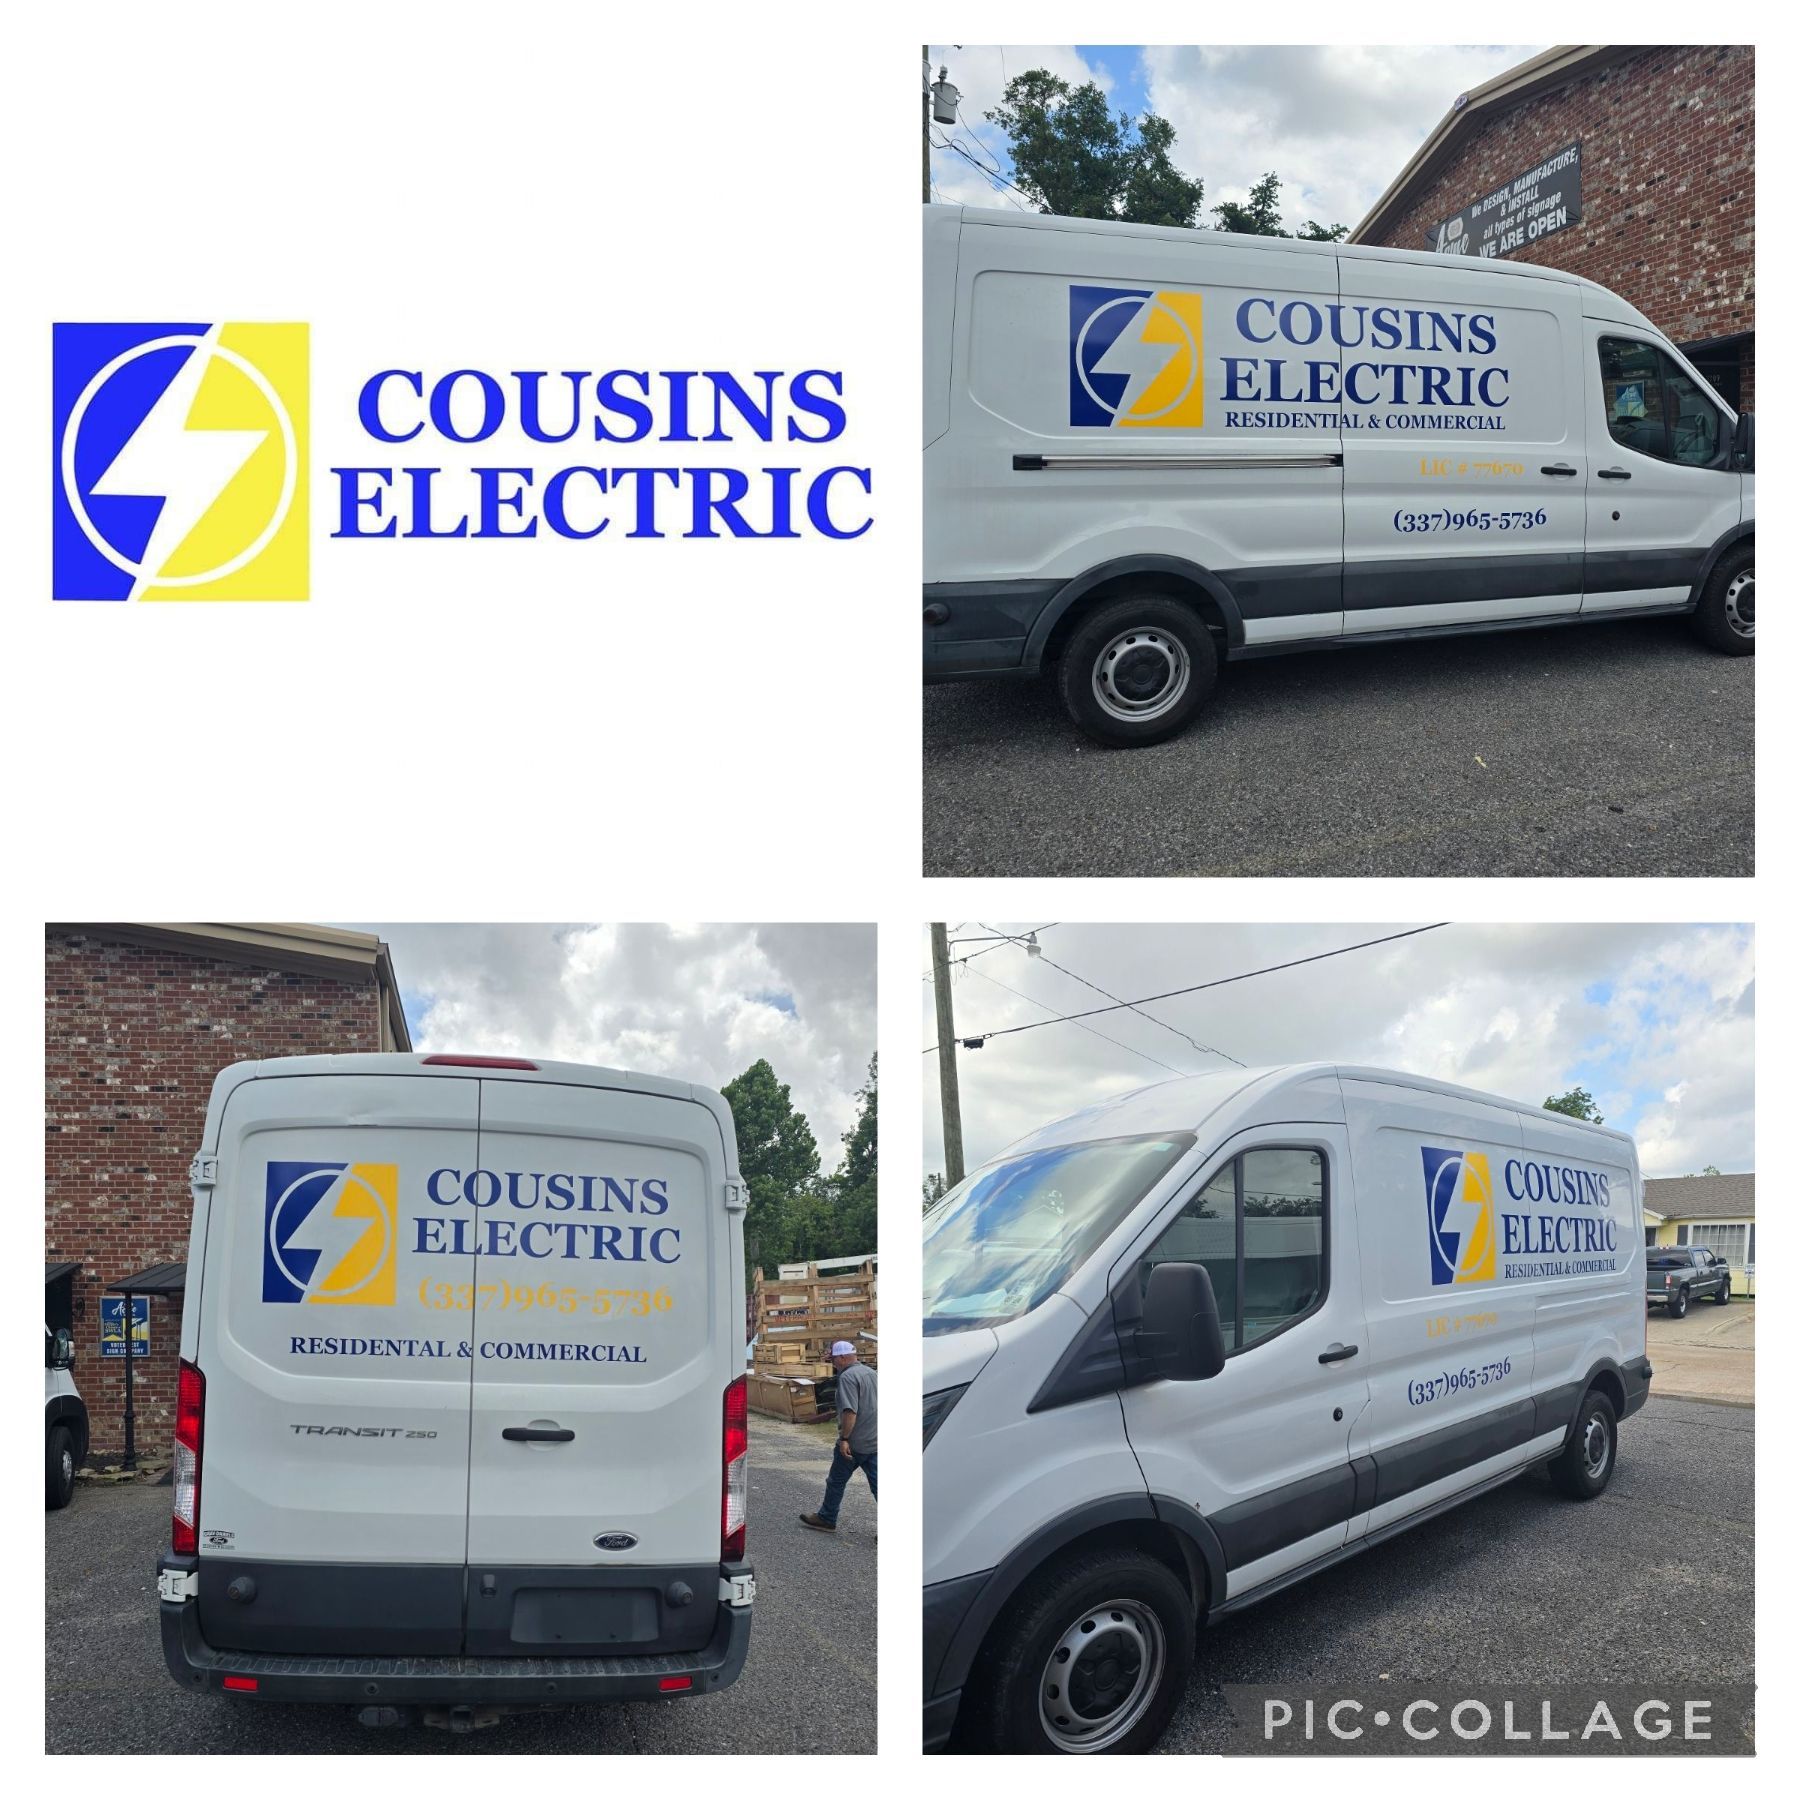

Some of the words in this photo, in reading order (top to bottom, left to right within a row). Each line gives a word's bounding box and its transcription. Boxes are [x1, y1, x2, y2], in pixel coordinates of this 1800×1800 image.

[1471, 204, 1481, 218] We
[1483, 186, 1511, 212] DESIGN,
[1513, 146, 1578, 195] MANUFACTURE,
[1500, 203, 1506, 216] &
[1508, 185, 1539, 212] INSTALL
[1479, 240, 1497, 258] WE
[1499, 226, 1525, 253] ARE
[1528, 206, 1567, 239] OPEN
[1483, 224, 1493, 239] all
[1494, 215, 1515, 235] types
[1516, 206, 1526, 223] of
[1527, 191, 1561, 218] signage
[1236, 297, 1498, 355] COUSINS
[1220, 356, 1510, 408] ELECTRIC
[358, 368, 847, 444] COUSINS
[1225, 411, 1364, 429] RESIDENTIAL
[1367, 413, 1381, 429] &
[1385, 413, 1506, 431] COMMERCIAL
[1420, 457, 1452, 476] LIC
[1457, 463, 1468, 475] #
[330, 466, 874, 540] ELECTRIC
[1393, 508, 1547, 533] (337)965-5736
[426, 1168, 669, 1215] COUSINS
[1504, 1158, 1611, 1208] COUSINS
[411, 1216, 681, 1264] ELECTRIC
[1501, 1213, 1618, 1256] ELECTRIC
[1504, 1261, 1565, 1279] RESIDENTIAL
[1564, 1263, 1571, 1273] &
[1572, 1258, 1617, 1275] COMMERCIAL
[418, 1275, 674, 1317] (337)965-5736
[290, 1336, 451, 1358] RESIDENTAL
[457, 1341, 472, 1358] &
[480, 1342, 647, 1363] COMMERCIAL
[1408, 1356, 1511, 1406] (337)965-5736
[290, 1424, 403, 1438] TRANSIT
[405, 1430, 438, 1439] 250
